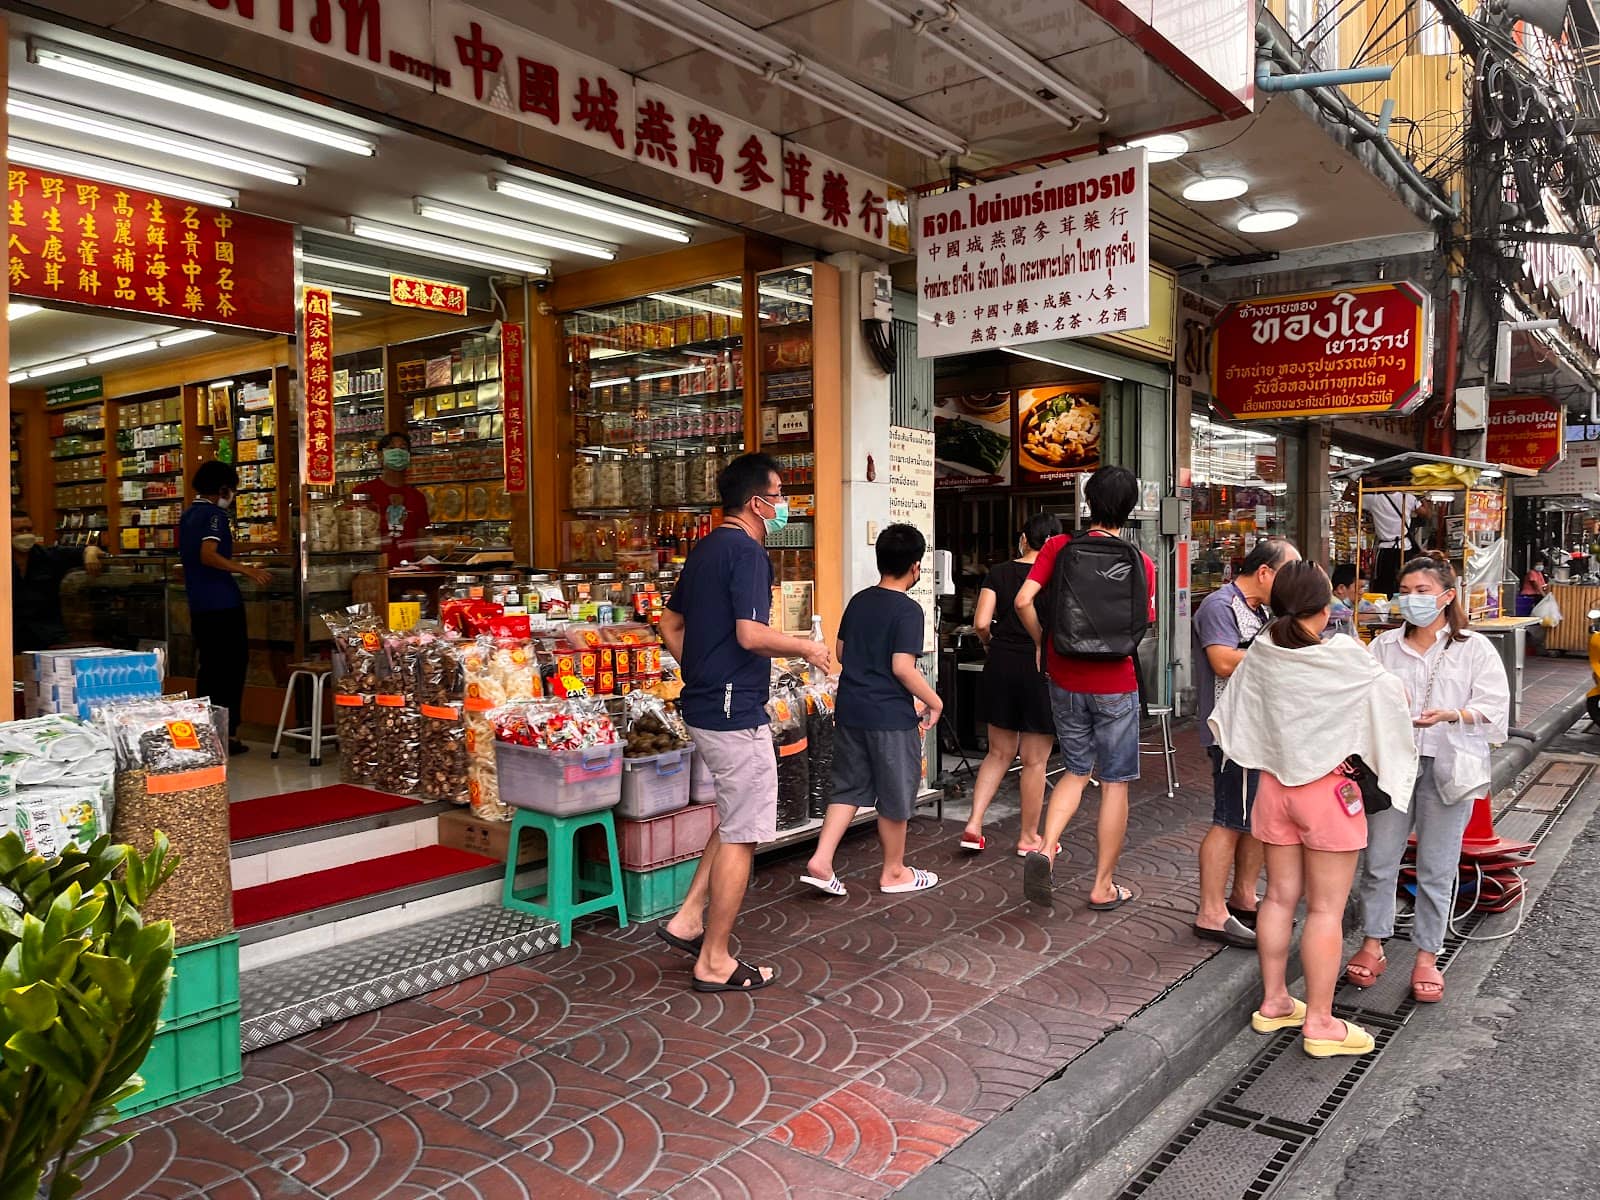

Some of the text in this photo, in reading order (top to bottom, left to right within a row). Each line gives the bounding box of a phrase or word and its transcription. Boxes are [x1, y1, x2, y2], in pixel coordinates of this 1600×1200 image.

[40, 176, 67, 292] 野生鹿茸
[145, 199, 171, 308] 生鮮海味
[181, 205, 206, 313] 名貴中藥
[214, 212, 237, 318] 中國名茶
[923, 208, 966, 238] หจก.
[952, 264, 975, 295] ยาจีน
[979, 260, 999, 290] รังนก
[1001, 252, 1017, 286] โสม
[1020, 244, 1076, 283] กระเพาะปลา
[1077, 238, 1101, 273] ใบชา
[1105, 230, 1136, 281] สุราจีน
[1251, 292, 1384, 344] ทองใบ
[1325, 328, 1410, 355] เยาวราช
